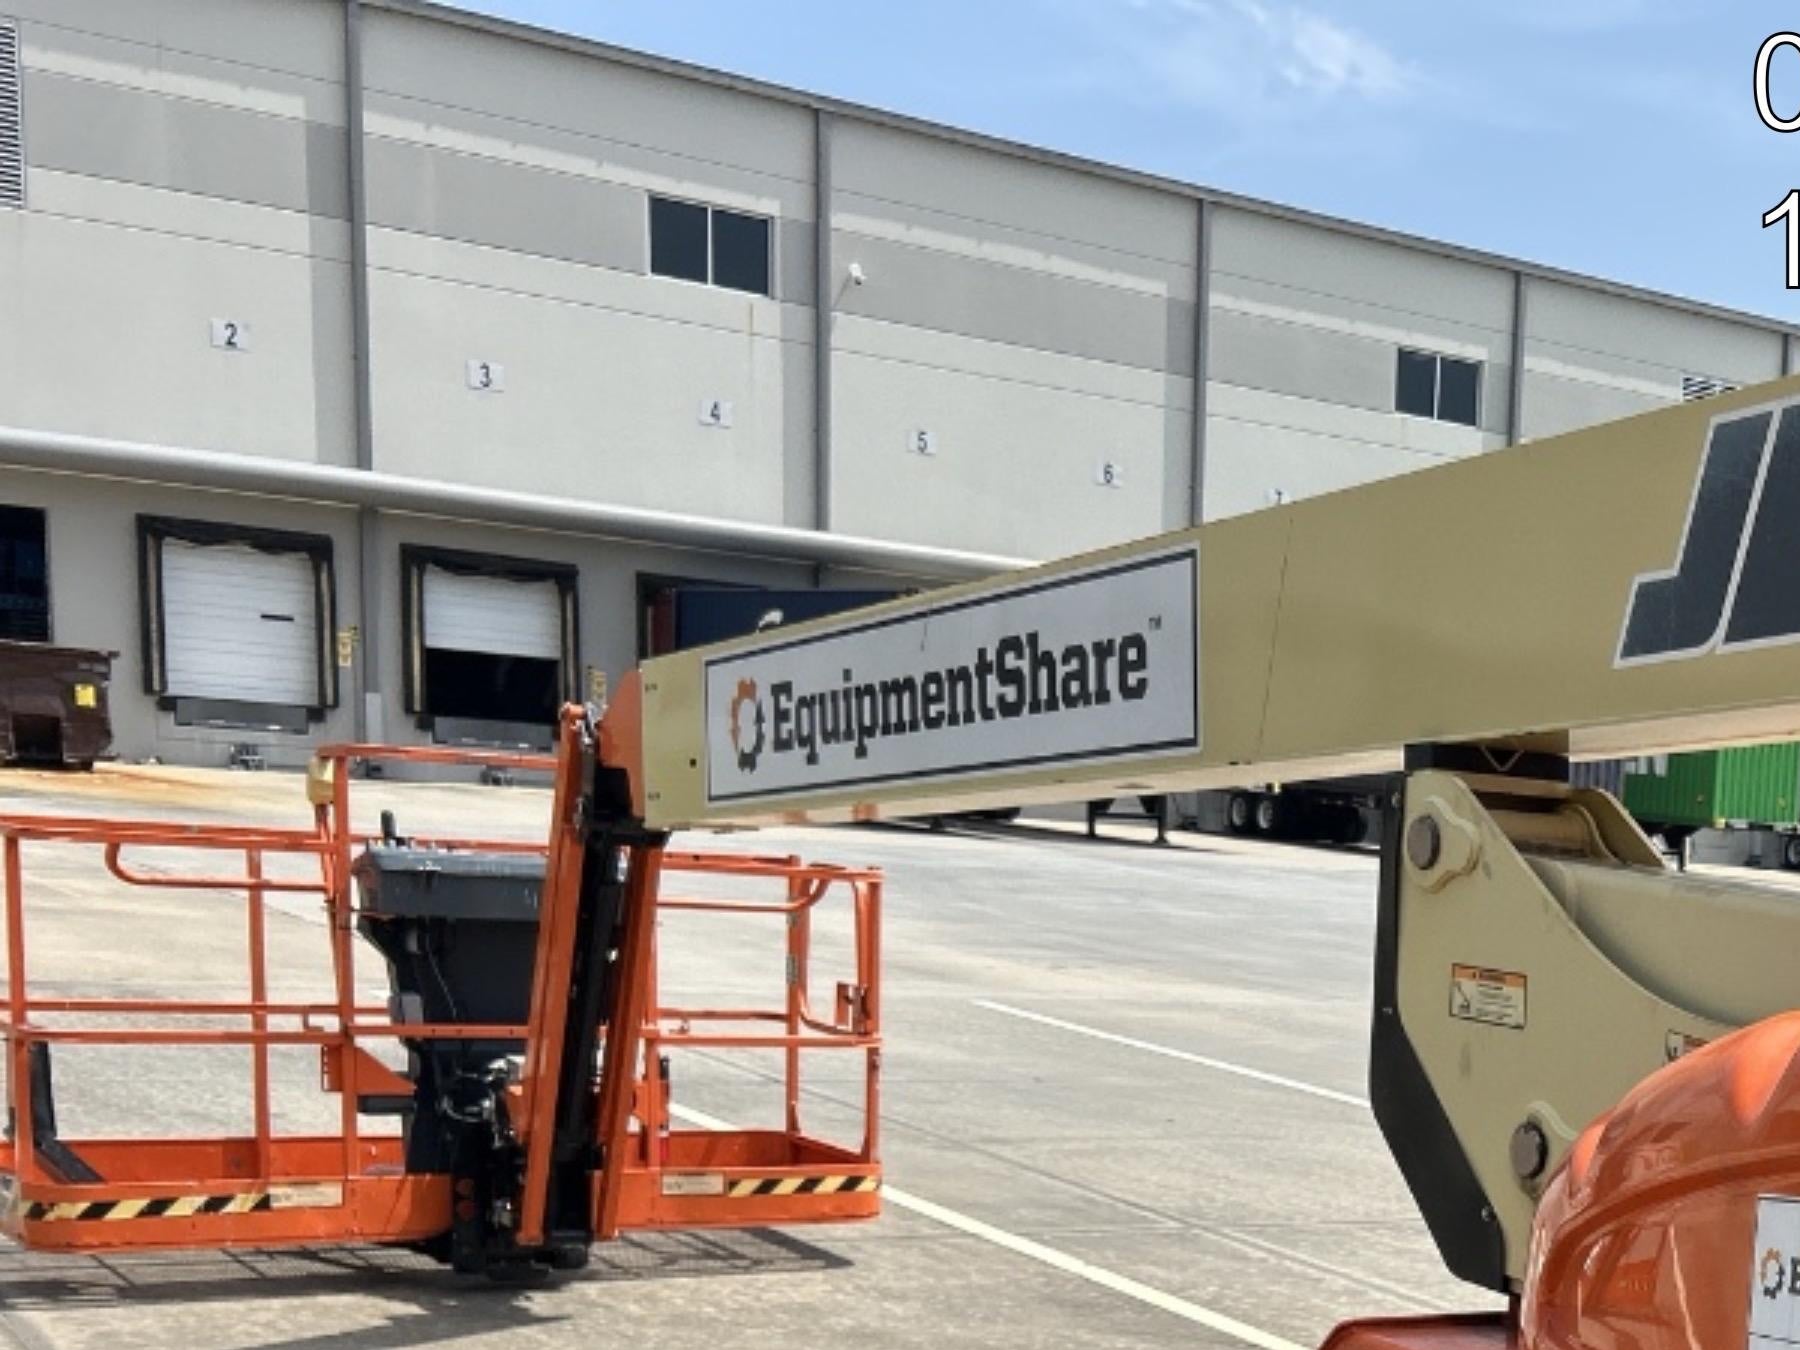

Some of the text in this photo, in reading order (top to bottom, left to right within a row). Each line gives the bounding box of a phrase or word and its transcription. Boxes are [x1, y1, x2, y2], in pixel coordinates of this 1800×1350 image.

[224, 322, 238, 349] 2
[479, 362, 492, 388] 3
[709, 400, 721, 424] 4
[917, 430, 928, 454] 5
[1103, 462, 1114, 485] 6
[770, 629, 1149, 765] EquipmentShare
